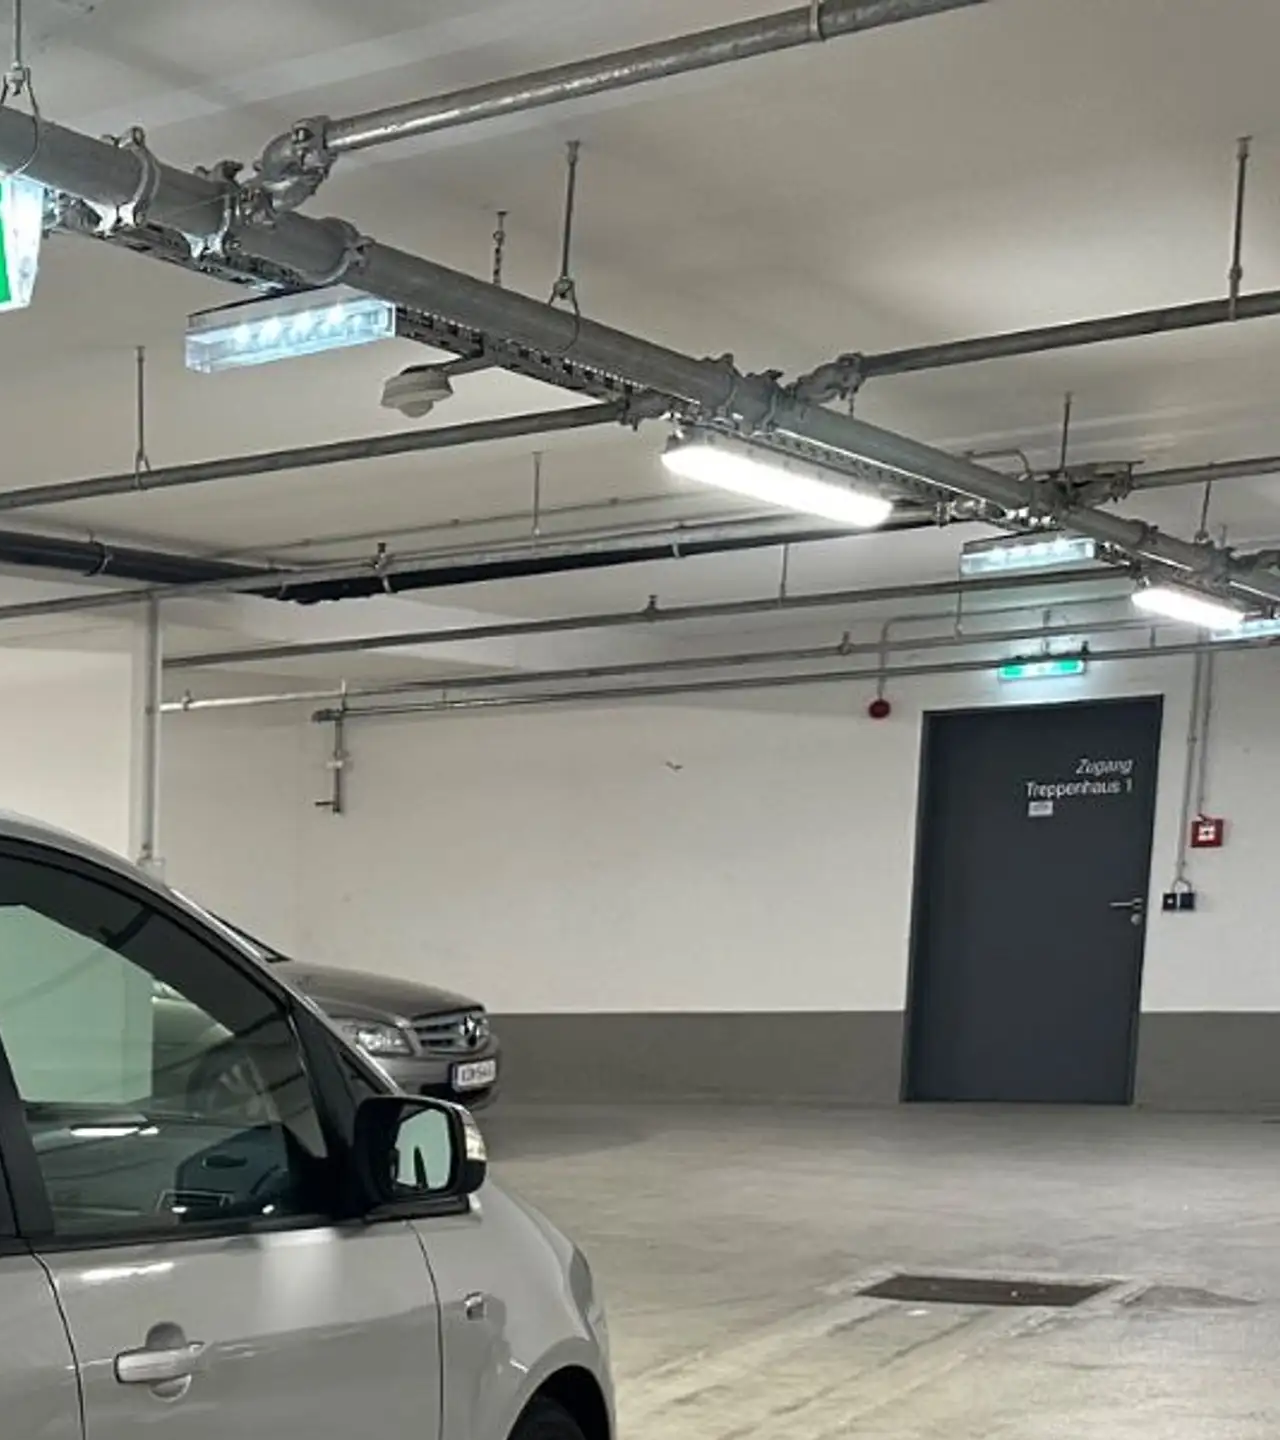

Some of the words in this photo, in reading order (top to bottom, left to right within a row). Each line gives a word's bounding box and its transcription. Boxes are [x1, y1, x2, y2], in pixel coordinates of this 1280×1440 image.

[1075, 758, 1133, 776] Zugang
[1026, 780, 1121, 799] Treppenhaus
[1125, 777, 1133, 793] 1
